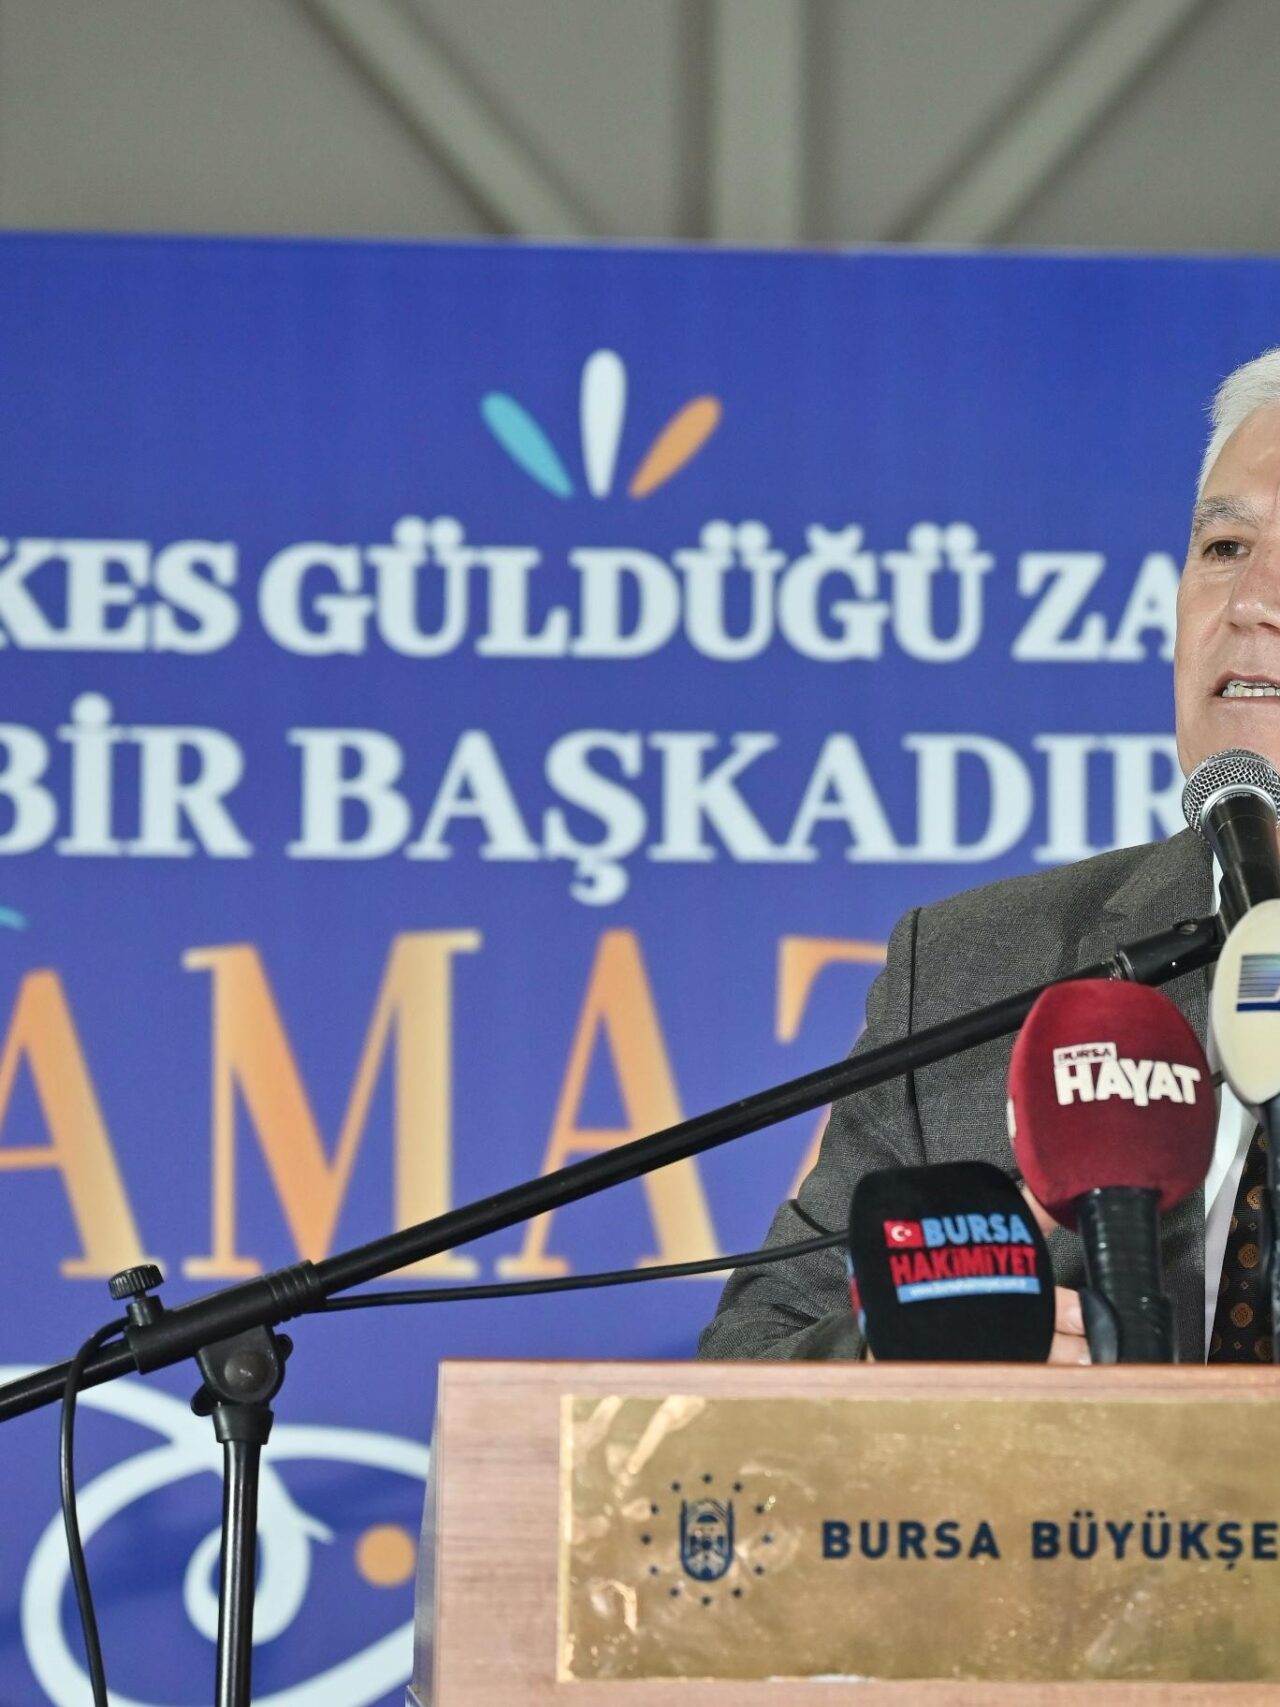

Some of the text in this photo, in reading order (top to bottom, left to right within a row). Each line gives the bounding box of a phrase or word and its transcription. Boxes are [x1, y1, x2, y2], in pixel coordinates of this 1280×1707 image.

[258, 516, 994, 662] GÜLDÜĞÜ
[286, 726, 1189, 906] BAŞKADIR
[0, 929, 888, 1282] AMA
[1054, 1058, 1201, 1106] HAYAT
[921, 1212, 1034, 1248] BURSA
[821, 1520, 1001, 1561] BURSA
